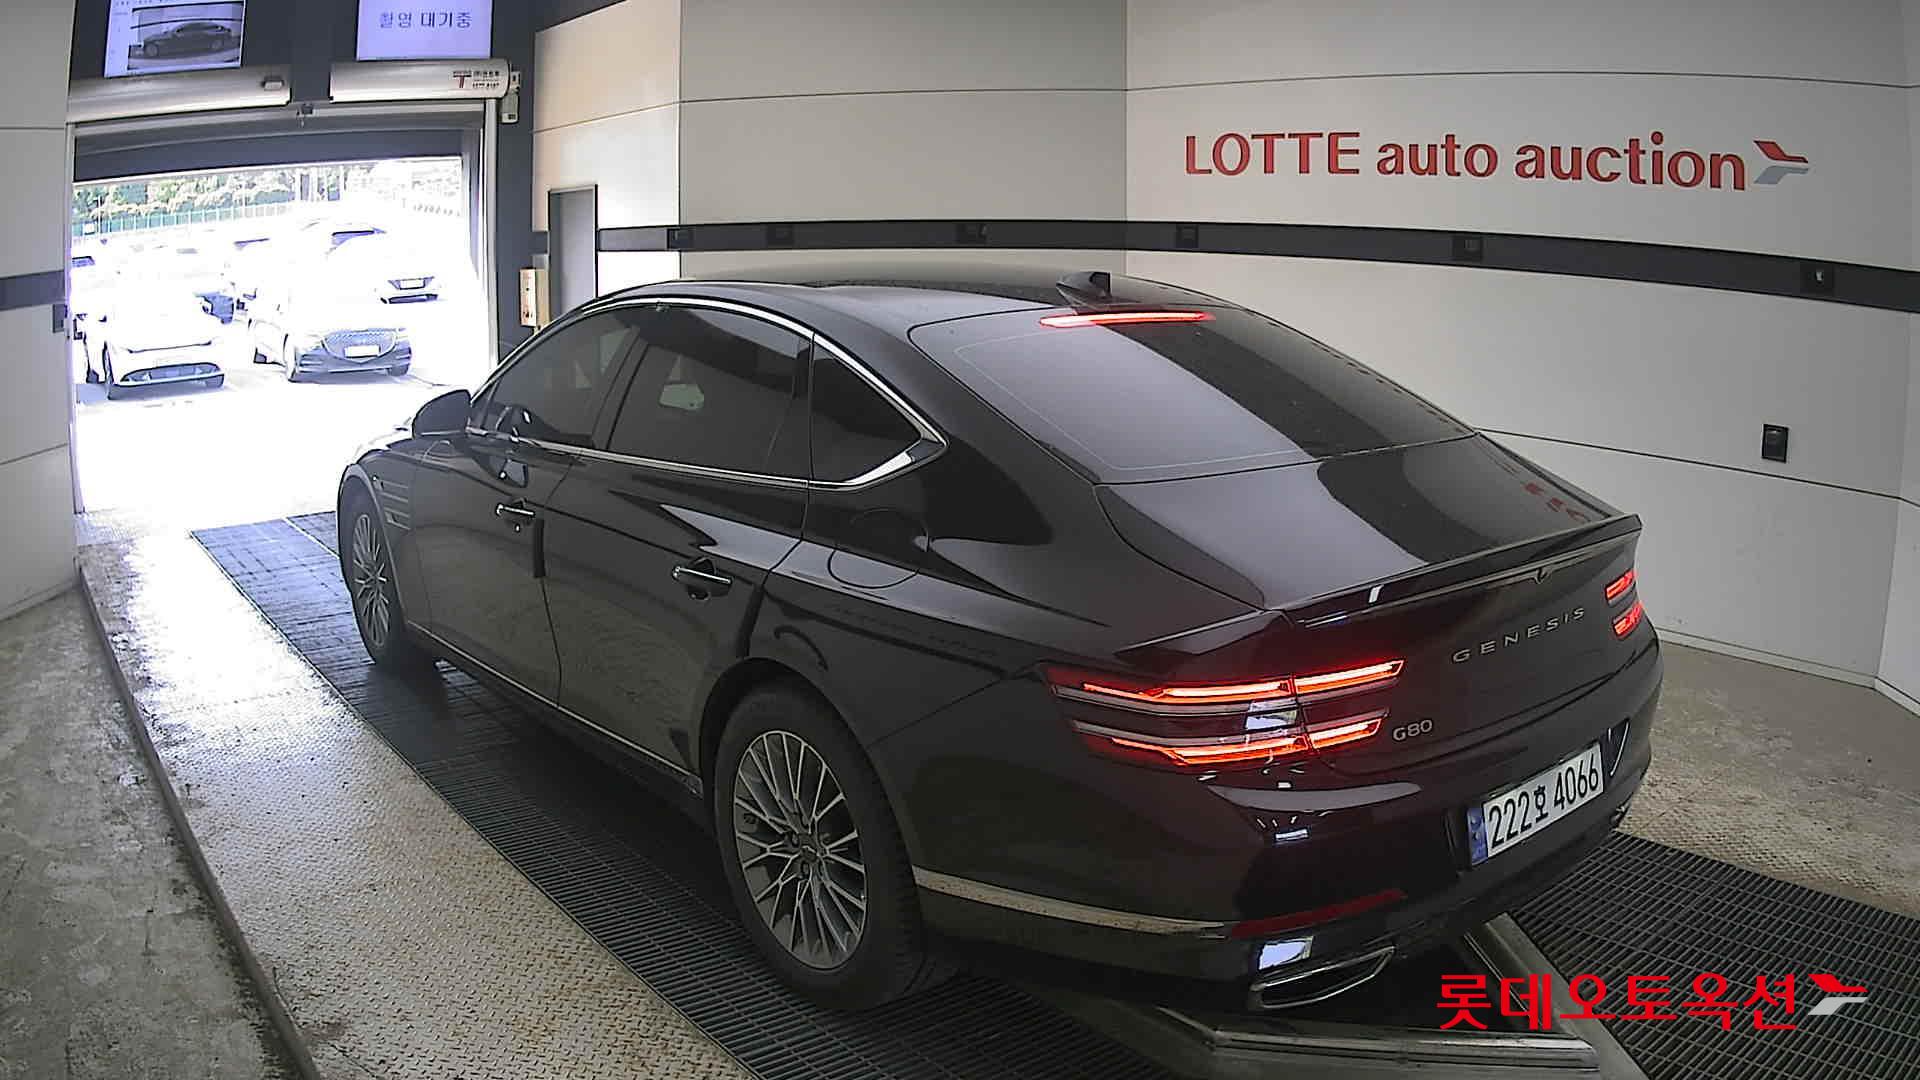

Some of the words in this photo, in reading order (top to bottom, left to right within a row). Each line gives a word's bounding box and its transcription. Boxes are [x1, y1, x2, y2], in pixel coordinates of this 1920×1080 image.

[420, 11, 473, 28] 대기중
[1185, 131, 1361, 177] LOTTE
[1376, 133, 1498, 177] auto
[1515, 132, 1745, 190] auction
[1452, 607, 1586, 663] GENESIS
[1392, 718, 1434, 742] G80
[1488, 785, 1549, 849] 222호
[1553, 753, 1599, 810] 4066
